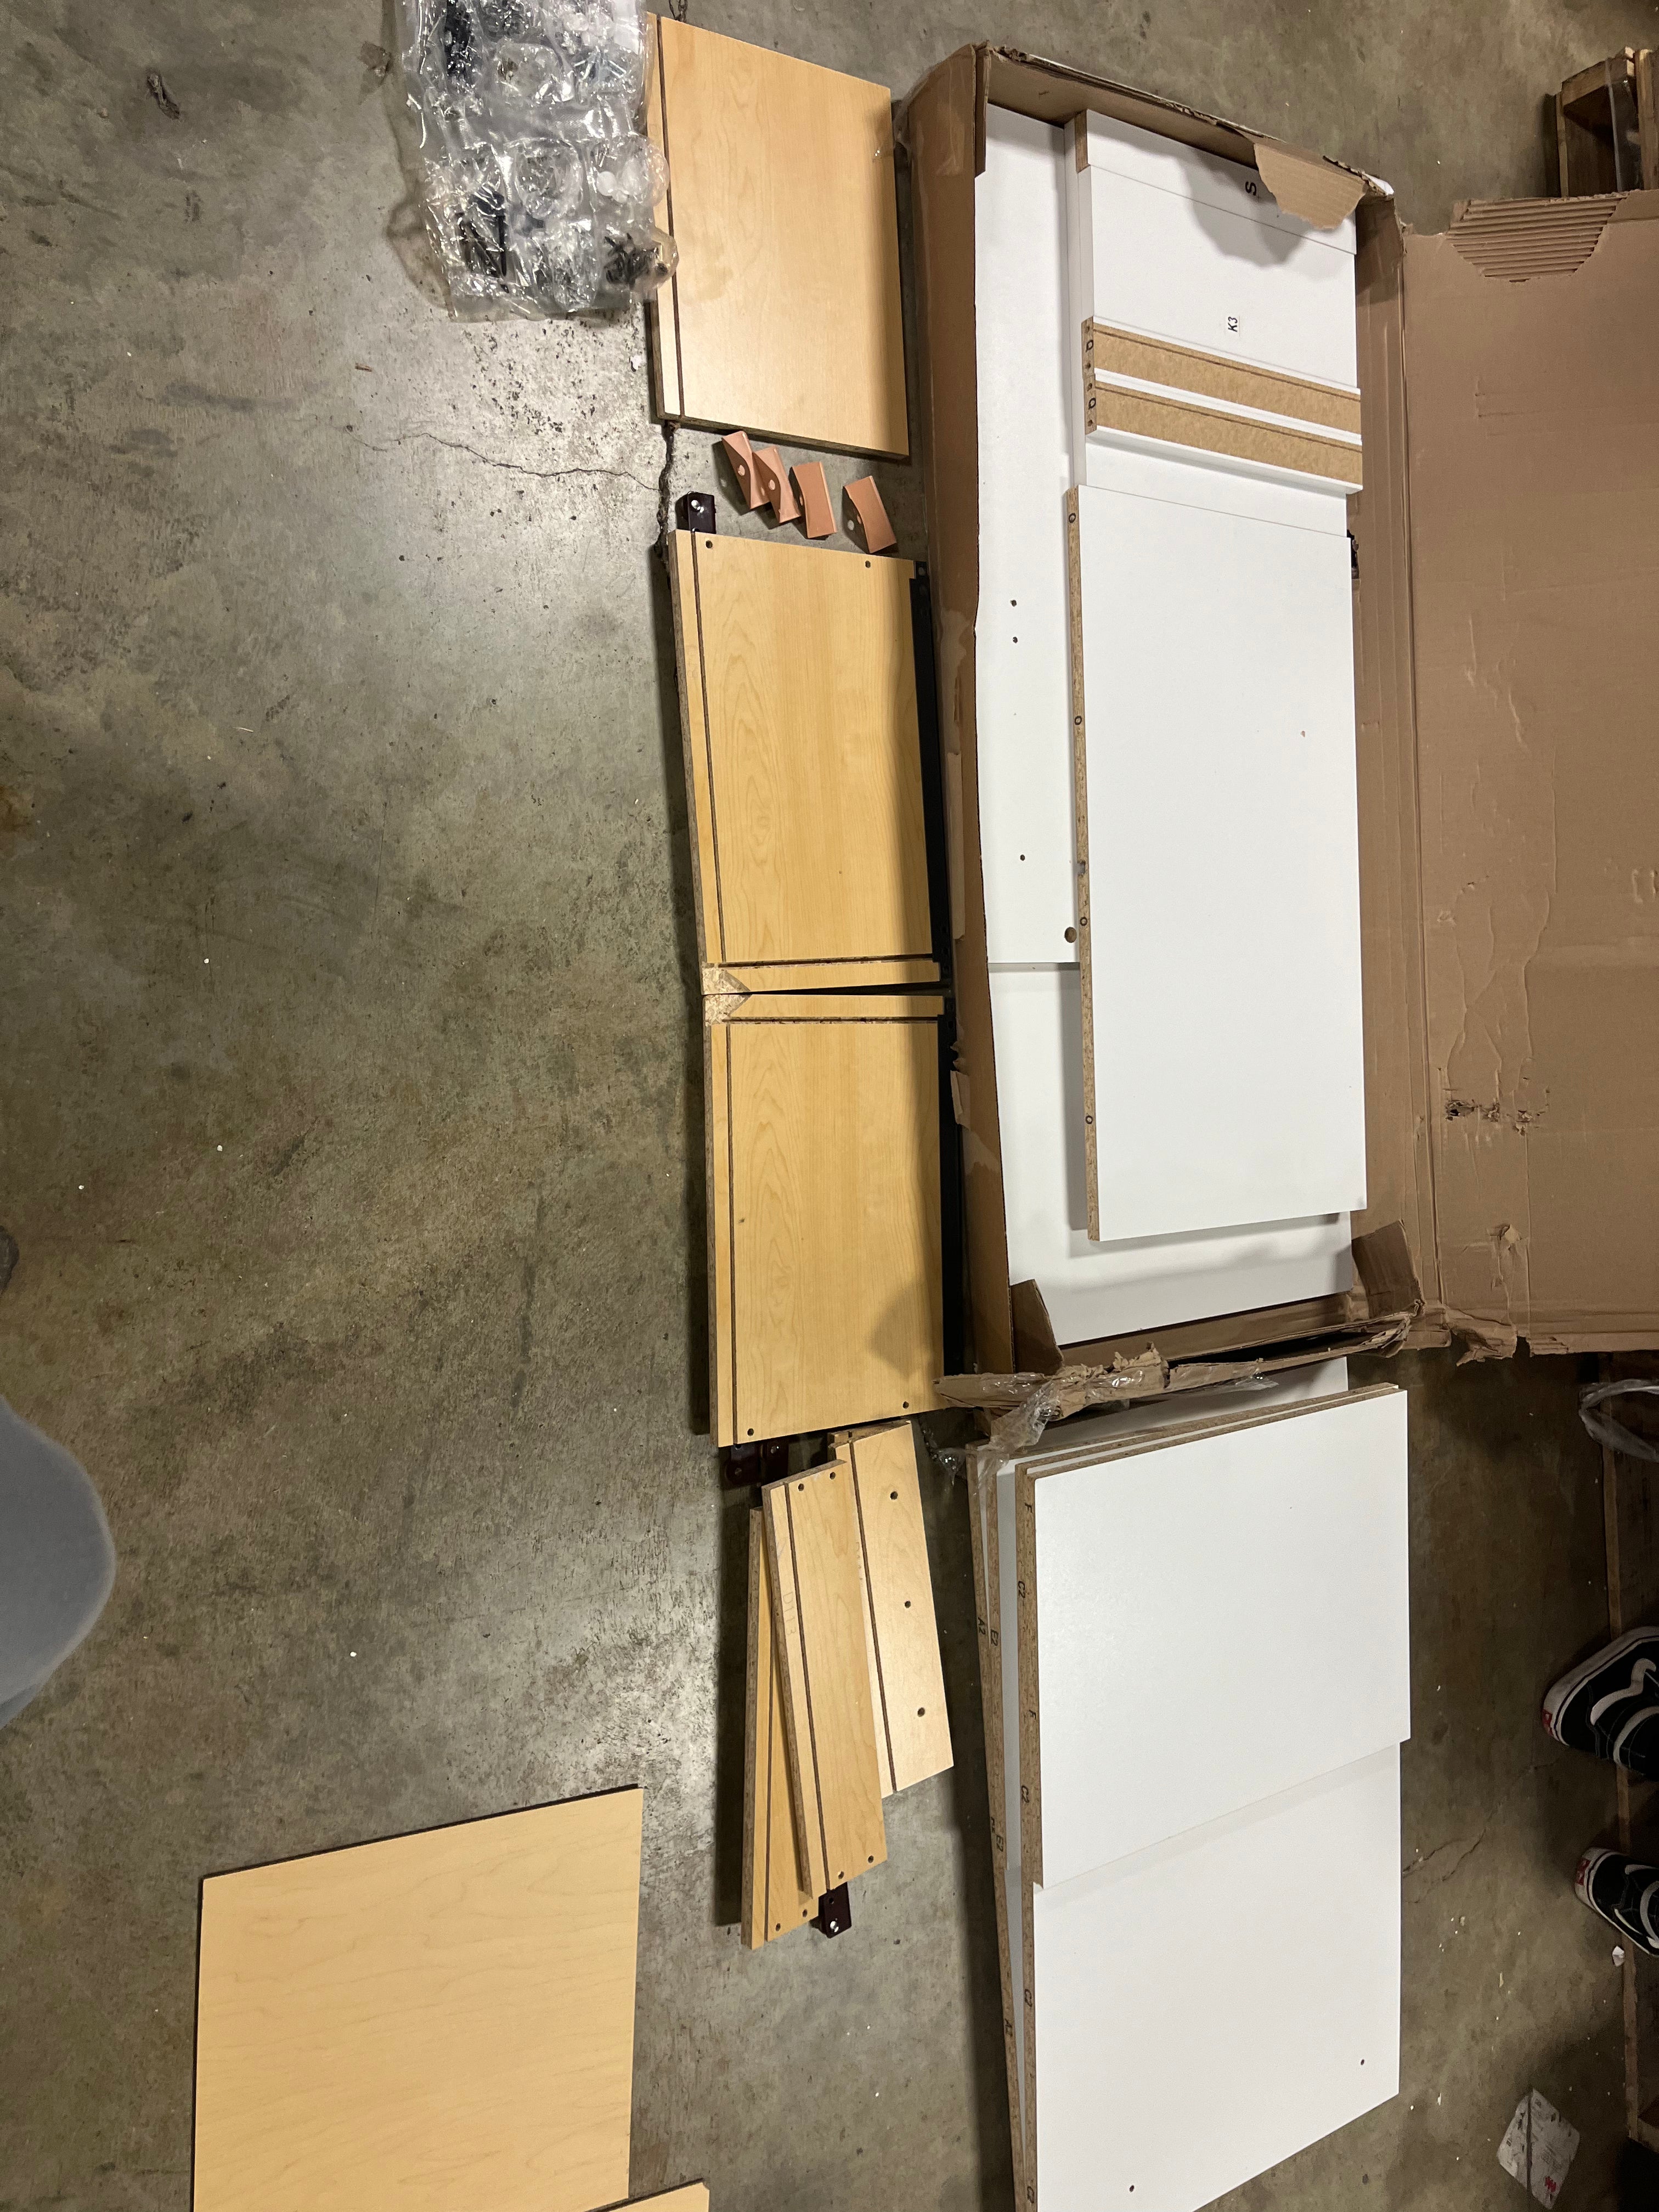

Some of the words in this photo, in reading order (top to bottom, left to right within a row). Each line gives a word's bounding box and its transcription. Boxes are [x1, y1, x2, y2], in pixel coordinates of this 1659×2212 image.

[1228, 316, 1238, 332] K3
[1025, 1502, 1032, 1513] F
[1018, 1580, 1025, 1599] C2
[978, 1617, 986, 1635] A2
[991, 1629, 998, 1646] E2
